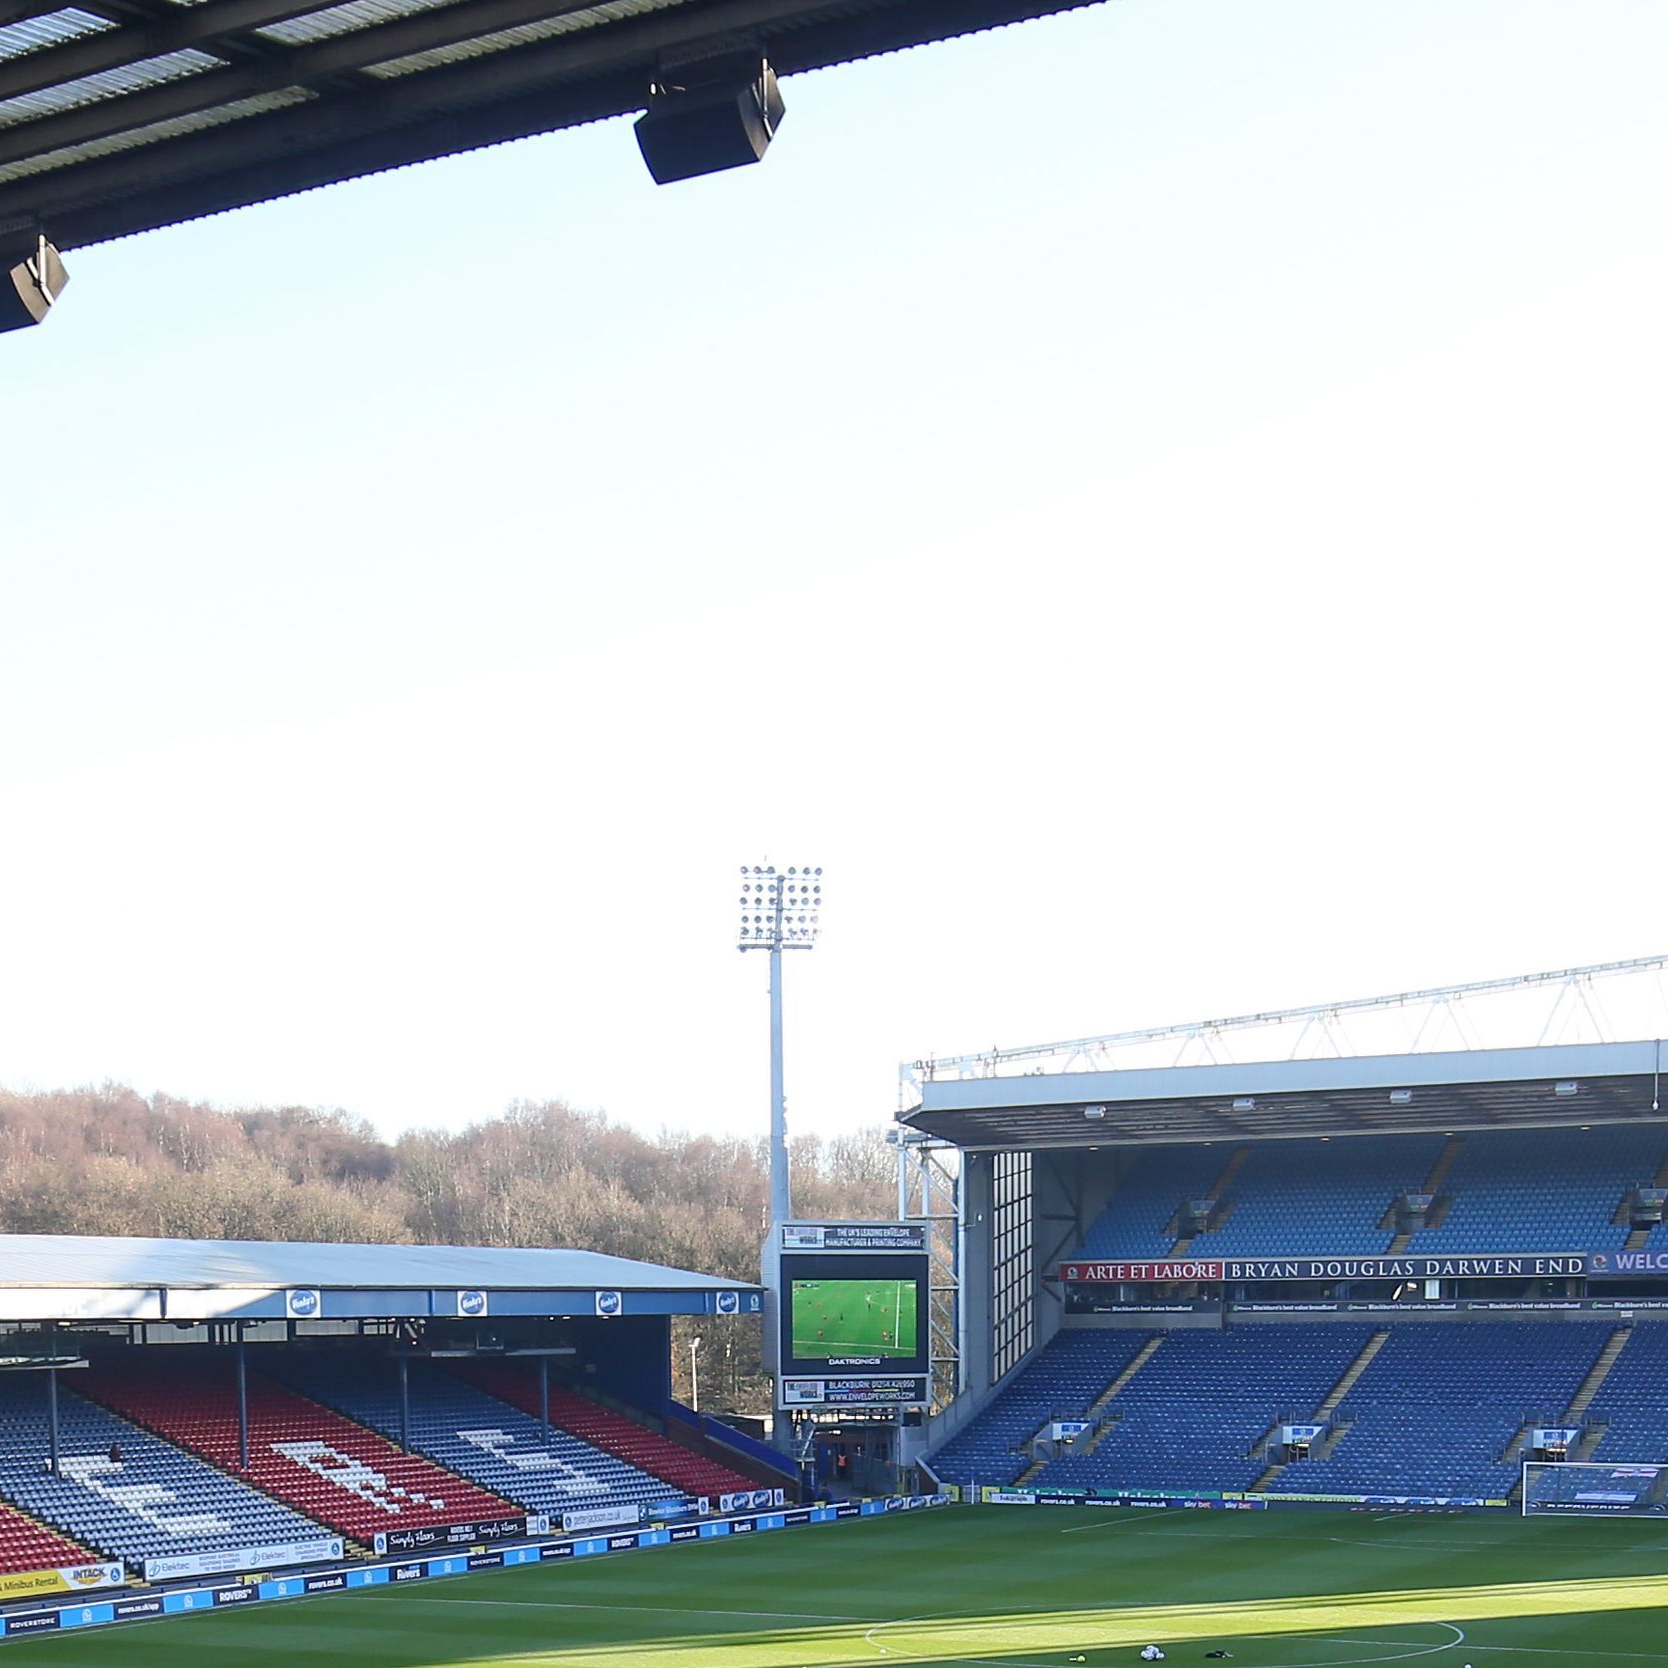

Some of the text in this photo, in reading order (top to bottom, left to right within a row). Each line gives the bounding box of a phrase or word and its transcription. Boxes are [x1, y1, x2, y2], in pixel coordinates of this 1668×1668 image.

[1085, 1263, 1217, 1280] ARTE ET LABORE
[1231, 1258, 1583, 1278] BRYAN DOUGLAS DARWEN END
[829, 1358, 881, 1366] DAKTRONICS
[1184, 1501, 1211, 1509] sky bet
[1225, 1501, 1252, 1510] sky bet
[478, 1524, 501, 1537] Simply
[390, 1535, 415, 1548] Simply
[261, 1551, 286, 1561] Elektec
[72, 1567, 106, 1580] INTACK
[161, 1562, 190, 1572] Elektec
[3, 1578, 32, 1592] Minibus
[34, 1575, 59, 1588] Rental
[308, 1576, 345, 1590] rovers.co.uk
[118, 1602, 161, 1615] rovers.co.uk/app
[9, 1617, 56, 1629] ROVERSTORE
